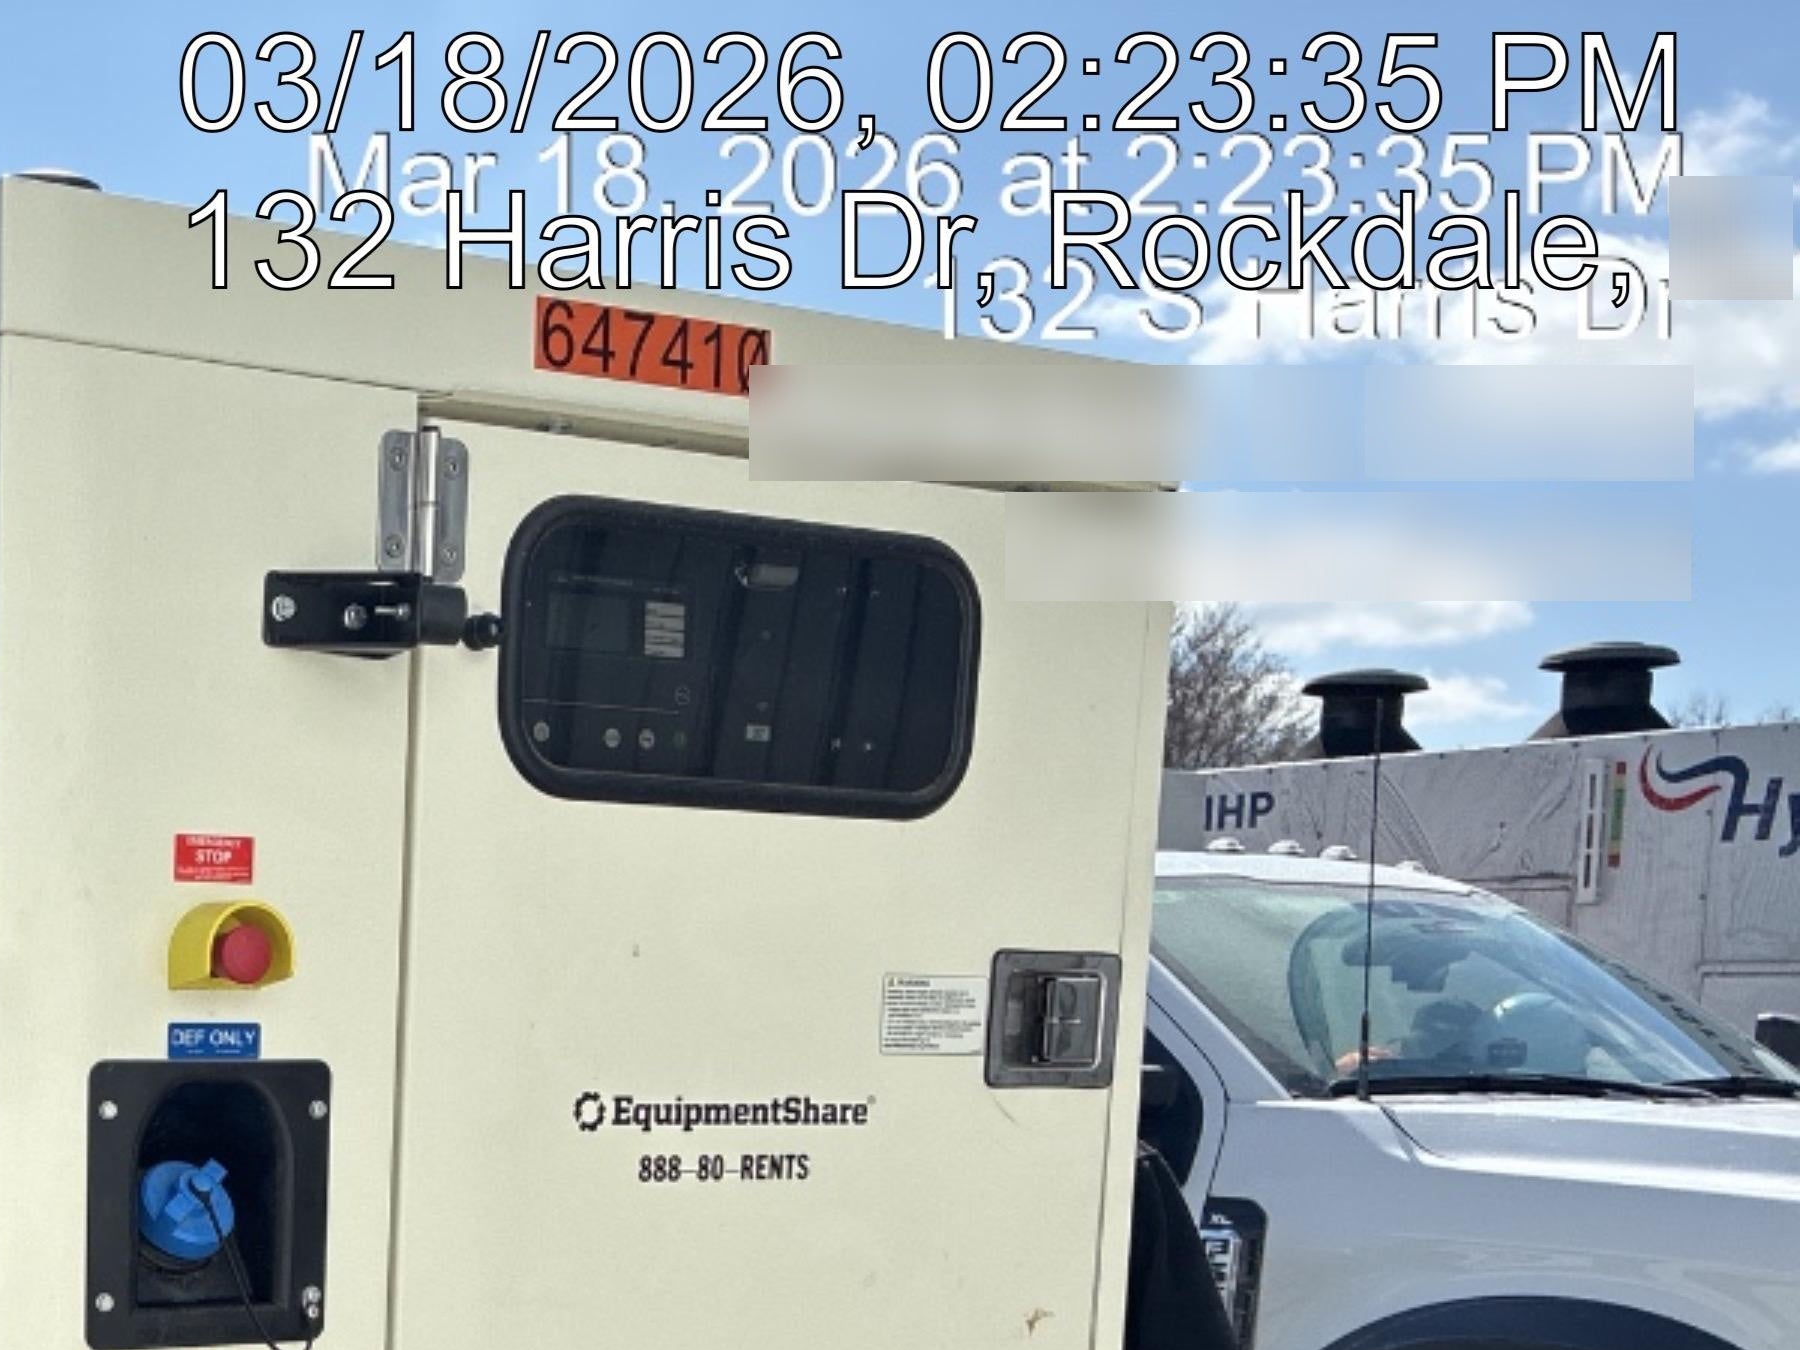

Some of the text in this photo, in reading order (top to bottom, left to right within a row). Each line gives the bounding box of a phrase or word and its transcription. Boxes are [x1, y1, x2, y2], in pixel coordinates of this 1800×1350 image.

[541, 299, 769, 394] 647410
[1203, 791, 1275, 832] IHP
[195, 848, 232, 864] STOP
[172, 1028, 255, 1048] DEF ONLY
[611, 1096, 870, 1132] EquipmentShare
[638, 1153, 811, 1182] 888-80-RENTS
